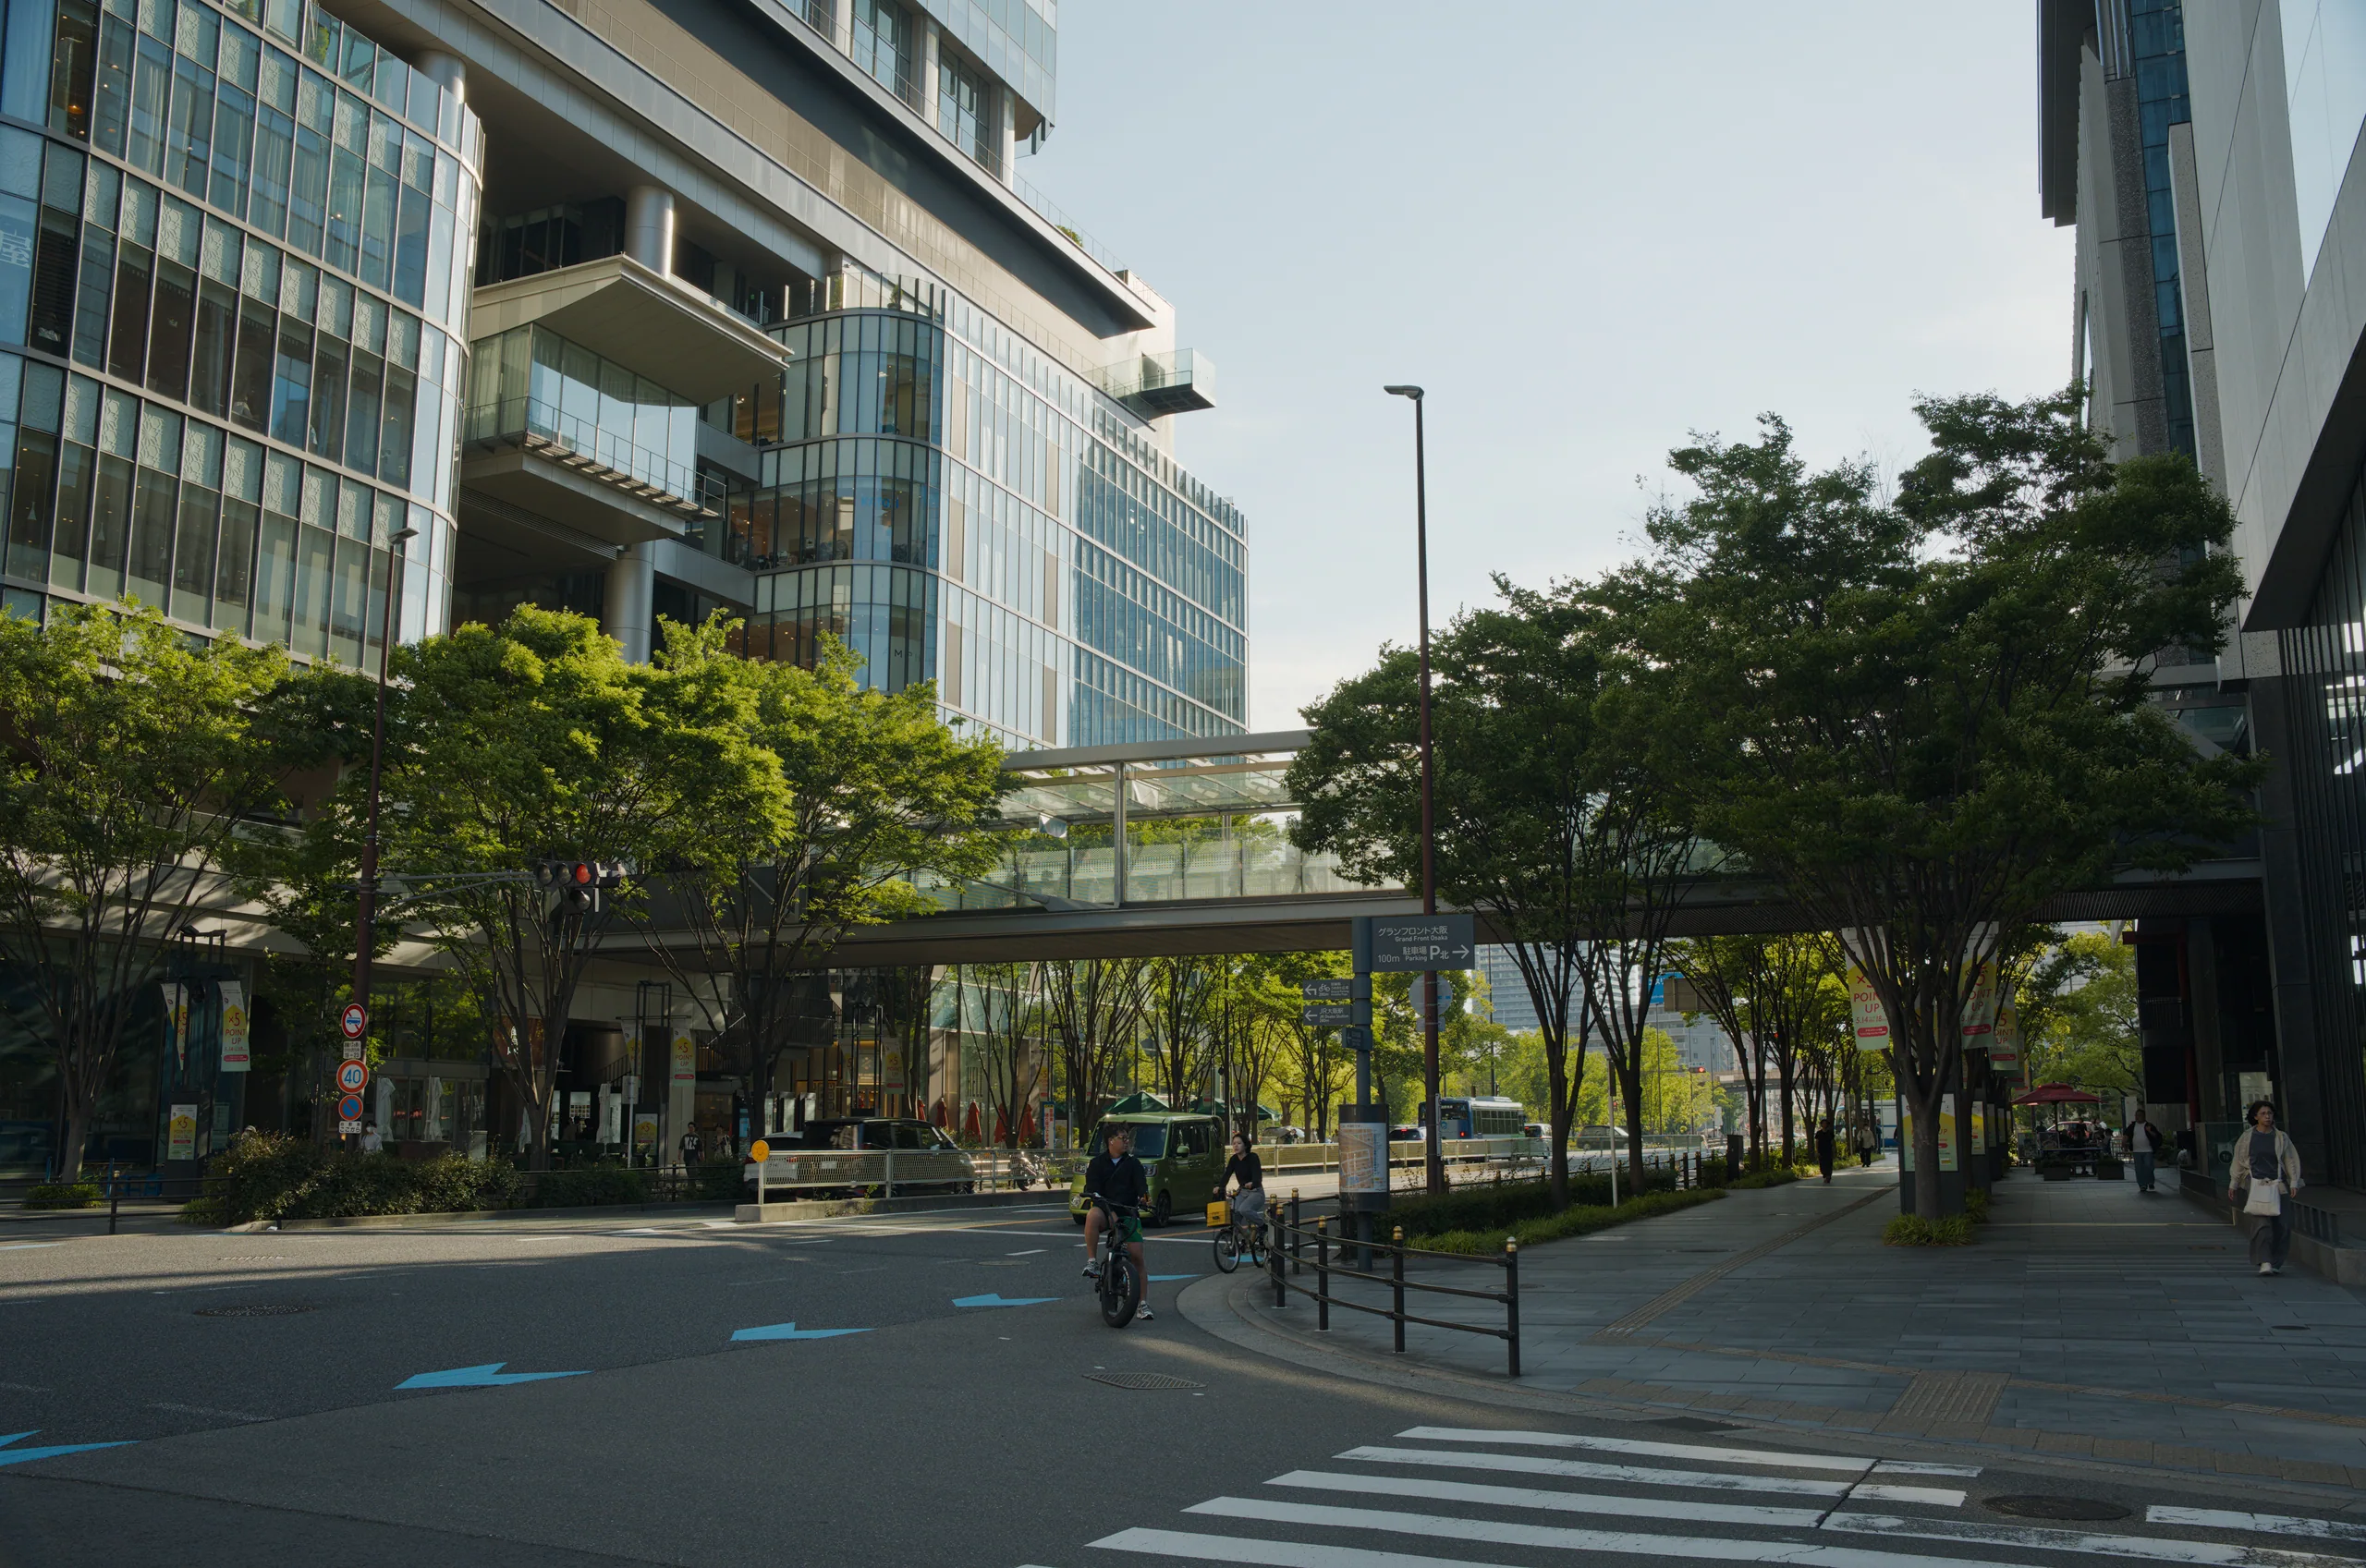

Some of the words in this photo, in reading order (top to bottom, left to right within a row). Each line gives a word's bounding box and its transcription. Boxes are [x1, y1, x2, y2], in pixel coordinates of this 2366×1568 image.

[1378, 925, 1448, 937] グランフロント大阪
[1402, 946, 1427, 955] 駐車場
[1378, 954, 1400, 963] 100m
[1865, 1003, 1880, 1014] UP
[1971, 1001, 1984, 1012] UP
[1995, 1037, 2008, 1045] UP
[344, 1069, 361, 1084] 40
